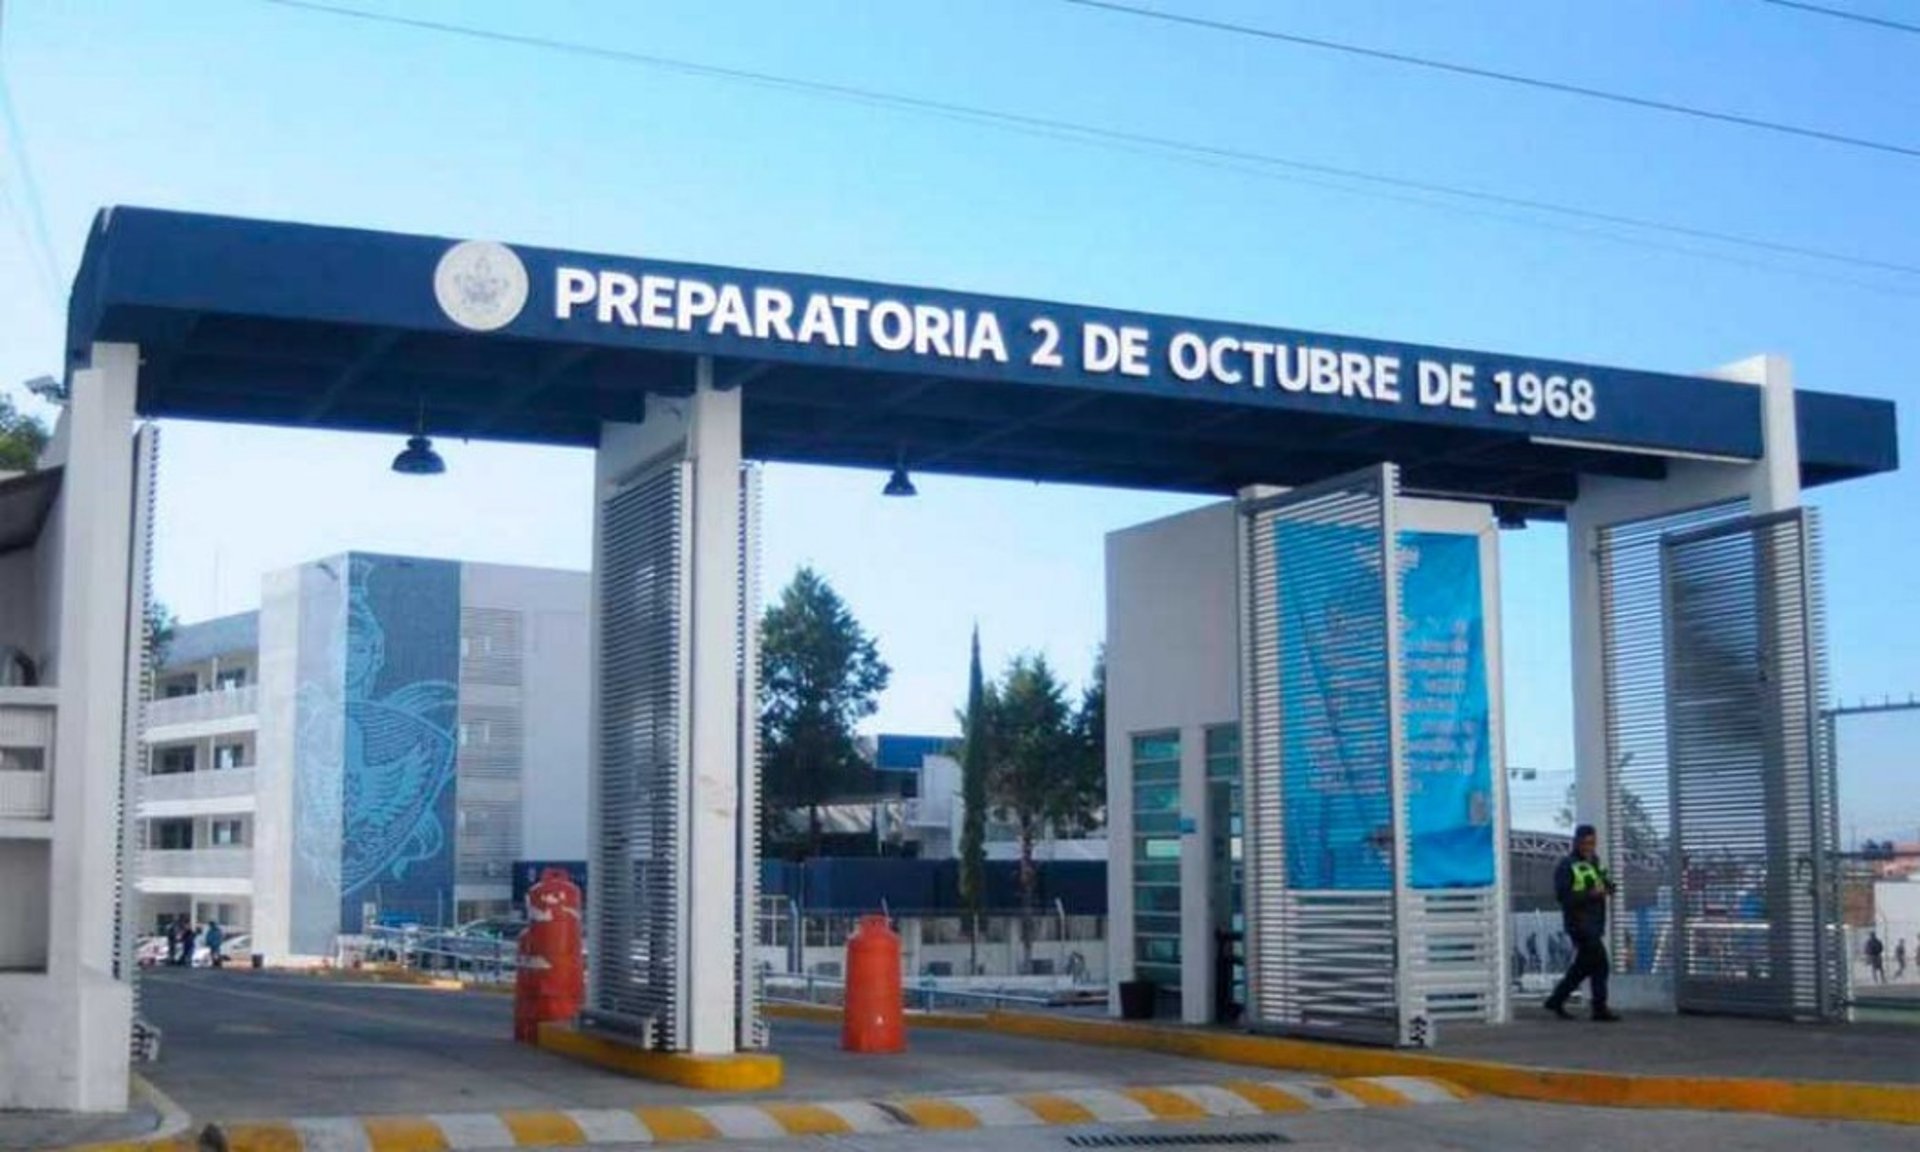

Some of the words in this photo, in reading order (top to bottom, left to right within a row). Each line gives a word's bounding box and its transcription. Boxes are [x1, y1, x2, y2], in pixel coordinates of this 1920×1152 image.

[555, 266, 1008, 364] PREPARATORIA
[1030, 317, 1063, 367] 2
[1083, 323, 1150, 377] DE
[1169, 332, 1402, 402] OCTUBRE
[1418, 359, 1476, 409] DE
[1494, 370, 1596, 422] 1968
